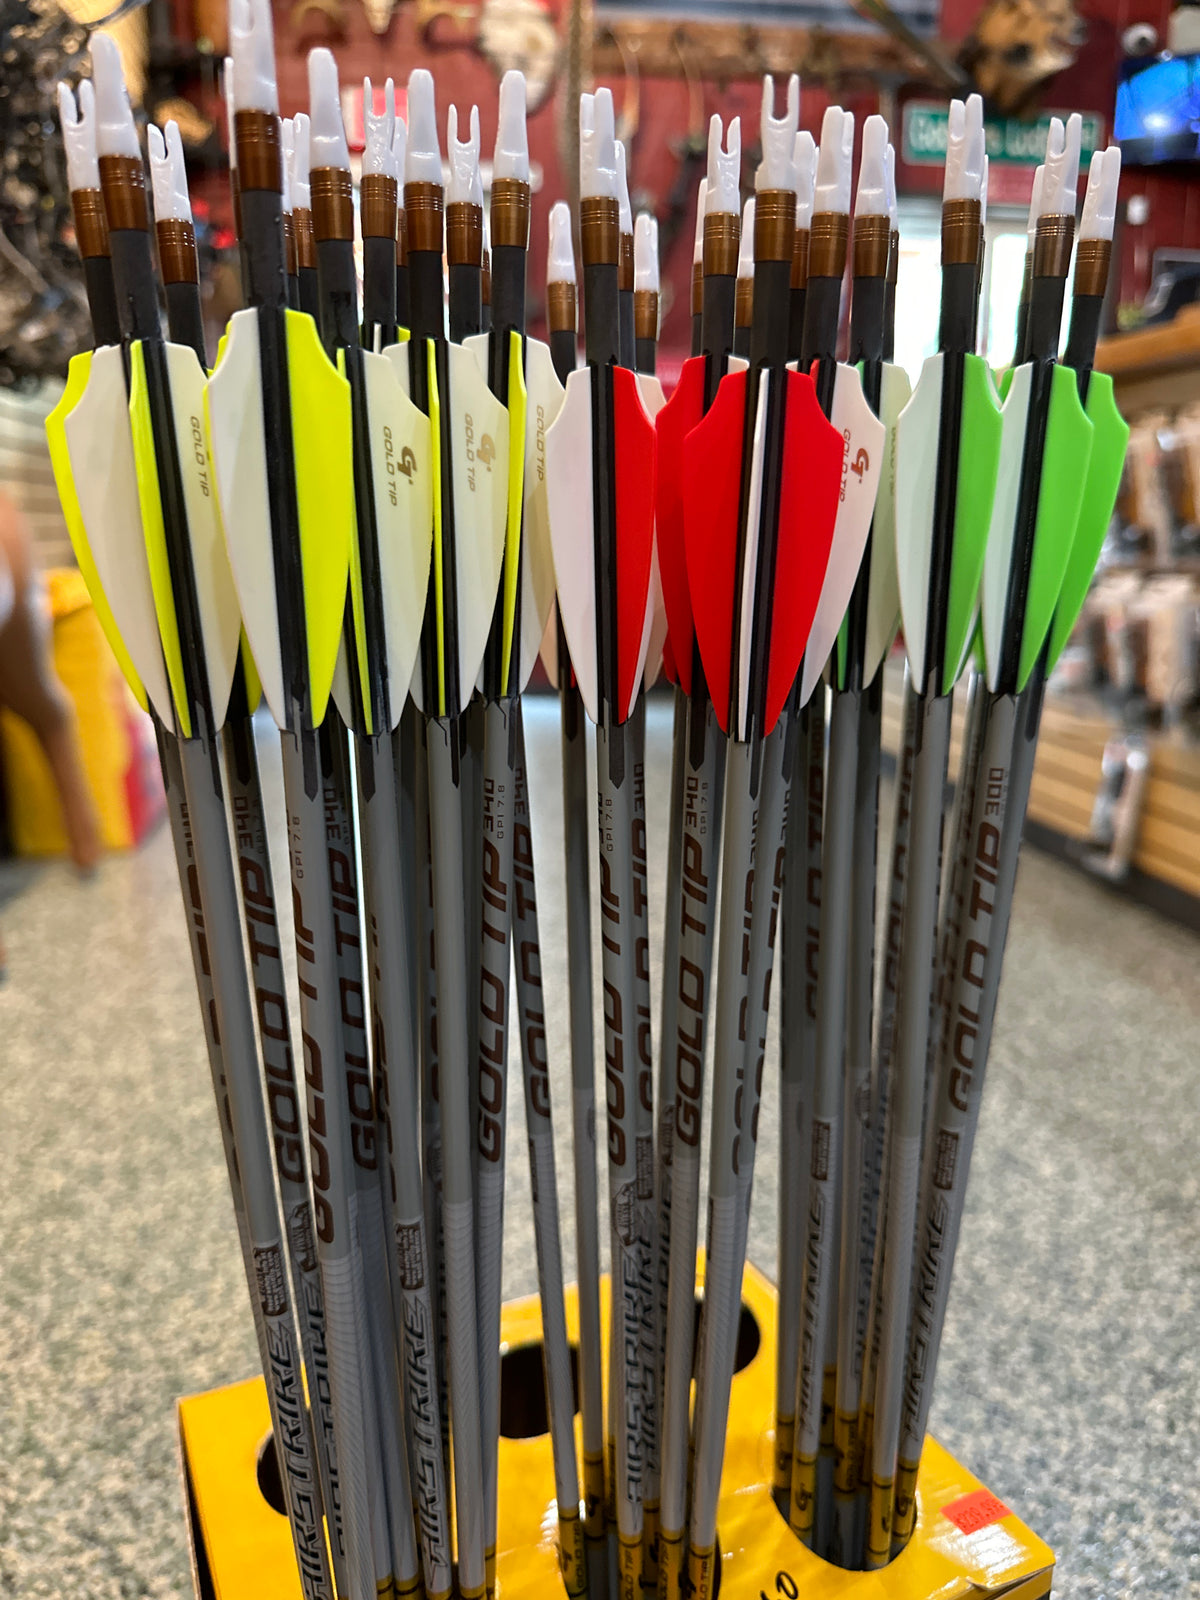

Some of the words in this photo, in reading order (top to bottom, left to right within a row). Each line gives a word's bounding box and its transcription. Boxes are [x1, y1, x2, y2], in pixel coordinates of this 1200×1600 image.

[383, 426, 395, 476] GOLD
[465, 413, 476, 462] GOLD
[536, 405, 545, 451] GOLD
[190, 415, 206, 466] GOLD
[198, 471, 210, 497] TIP
[467, 467, 476, 492] TIP
[536, 457, 545, 481] TIP
[388, 481, 398, 507] TIP
[233, 796, 255, 851] 340
[324, 787, 341, 842] 340
[483, 777, 495, 833] 340
[497, 785, 505, 808] 7.8
[604, 798, 613, 821] 7.8
[685, 776, 699, 829] 340
[291, 816, 301, 842] 7.8
[496, 814, 505, 839] GPI
[606, 827, 614, 852] GPI
[966, 820, 1000, 921] TIP
[984, 766, 1005, 817] 300
[294, 850, 304, 879] GPI
[481, 836, 507, 945] TIP
[513, 822, 537, 922] TIP
[681, 832, 709, 937] TIP
[240, 855, 280, 967] TIP
[328, 847, 360, 957] TIP
[340, 977, 378, 1171] GOLD
[478, 965, 505, 1163] GOLD
[675, 956, 705, 1147] GOLD
[254, 986, 306, 1184] GOLD
[623, 1252, 643, 1502] AIRSTRIKE
[403, 1296, 448, 1569] AIRSTRIKE
